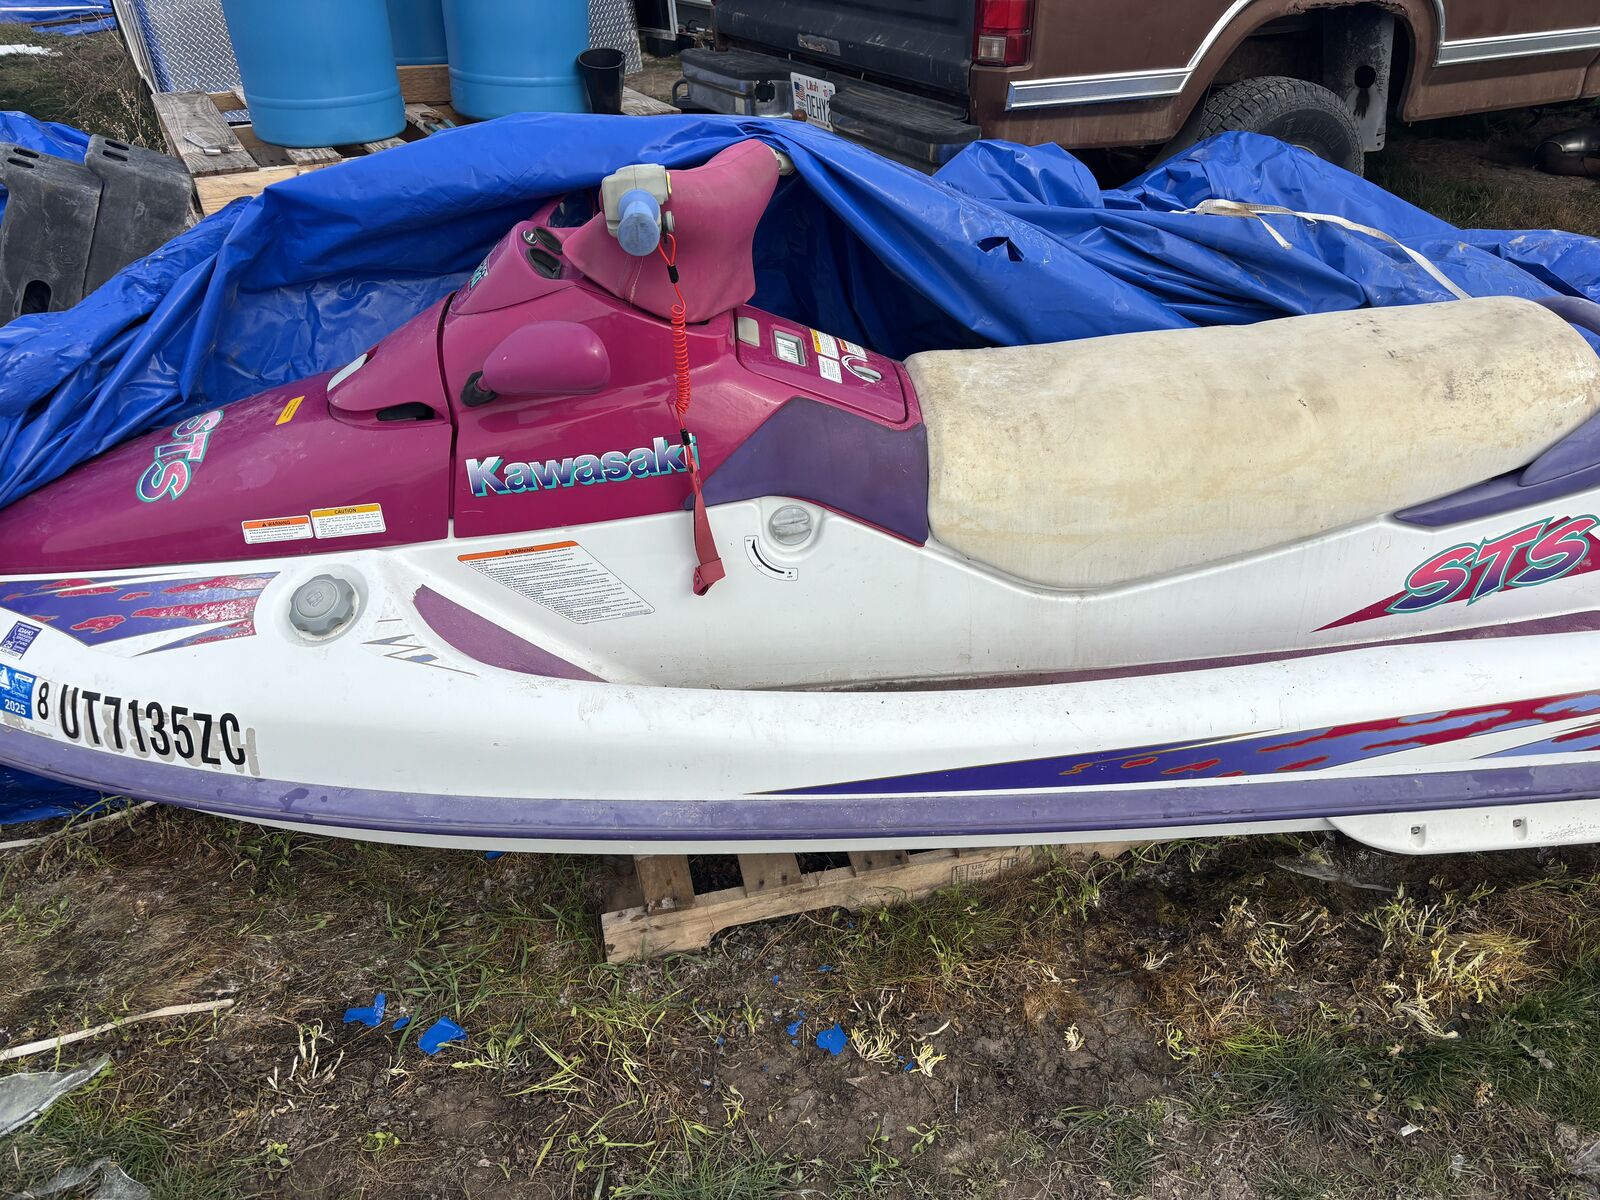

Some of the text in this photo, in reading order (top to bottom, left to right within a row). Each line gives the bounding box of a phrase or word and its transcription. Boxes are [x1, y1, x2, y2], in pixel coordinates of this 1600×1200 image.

[136, 410, 224, 503] STS
[1384, 514, 1600, 614] STS
[4, 699, 26, 715] 2025
[60, 684, 246, 766] UT7135ZC
